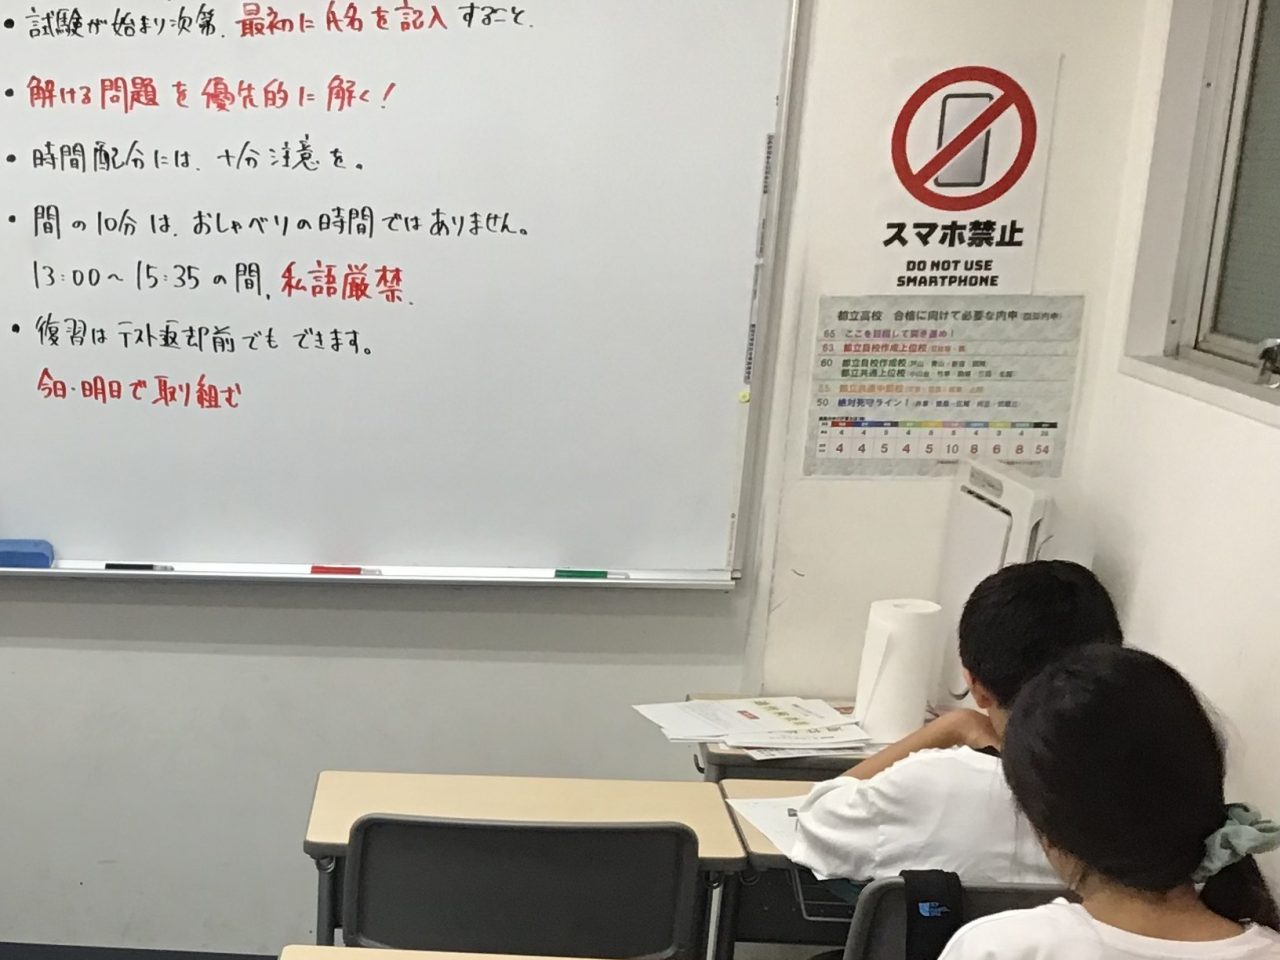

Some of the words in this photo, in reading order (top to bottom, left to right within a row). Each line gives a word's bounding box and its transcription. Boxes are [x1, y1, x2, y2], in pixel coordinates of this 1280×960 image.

[883, 220, 1024, 247] スマホ禁止
[906, 260, 927, 272] DO
[930, 260, 961, 271] NOT
[964, 260, 993, 271] USE
[897, 275, 999, 287] SMARTPHONE
[836, 444, 844, 453] 4
[858, 444, 866, 453] 4
[880, 444, 888, 453] 5
[902, 444, 910, 453] 4
[925, 444, 933, 453] 5
[946, 444, 959, 454] 10
[970, 444, 978, 454] 8
[992, 444, 1001, 454] 6
[1015, 444, 1024, 454] 8
[1035, 444, 1049, 454] 54
